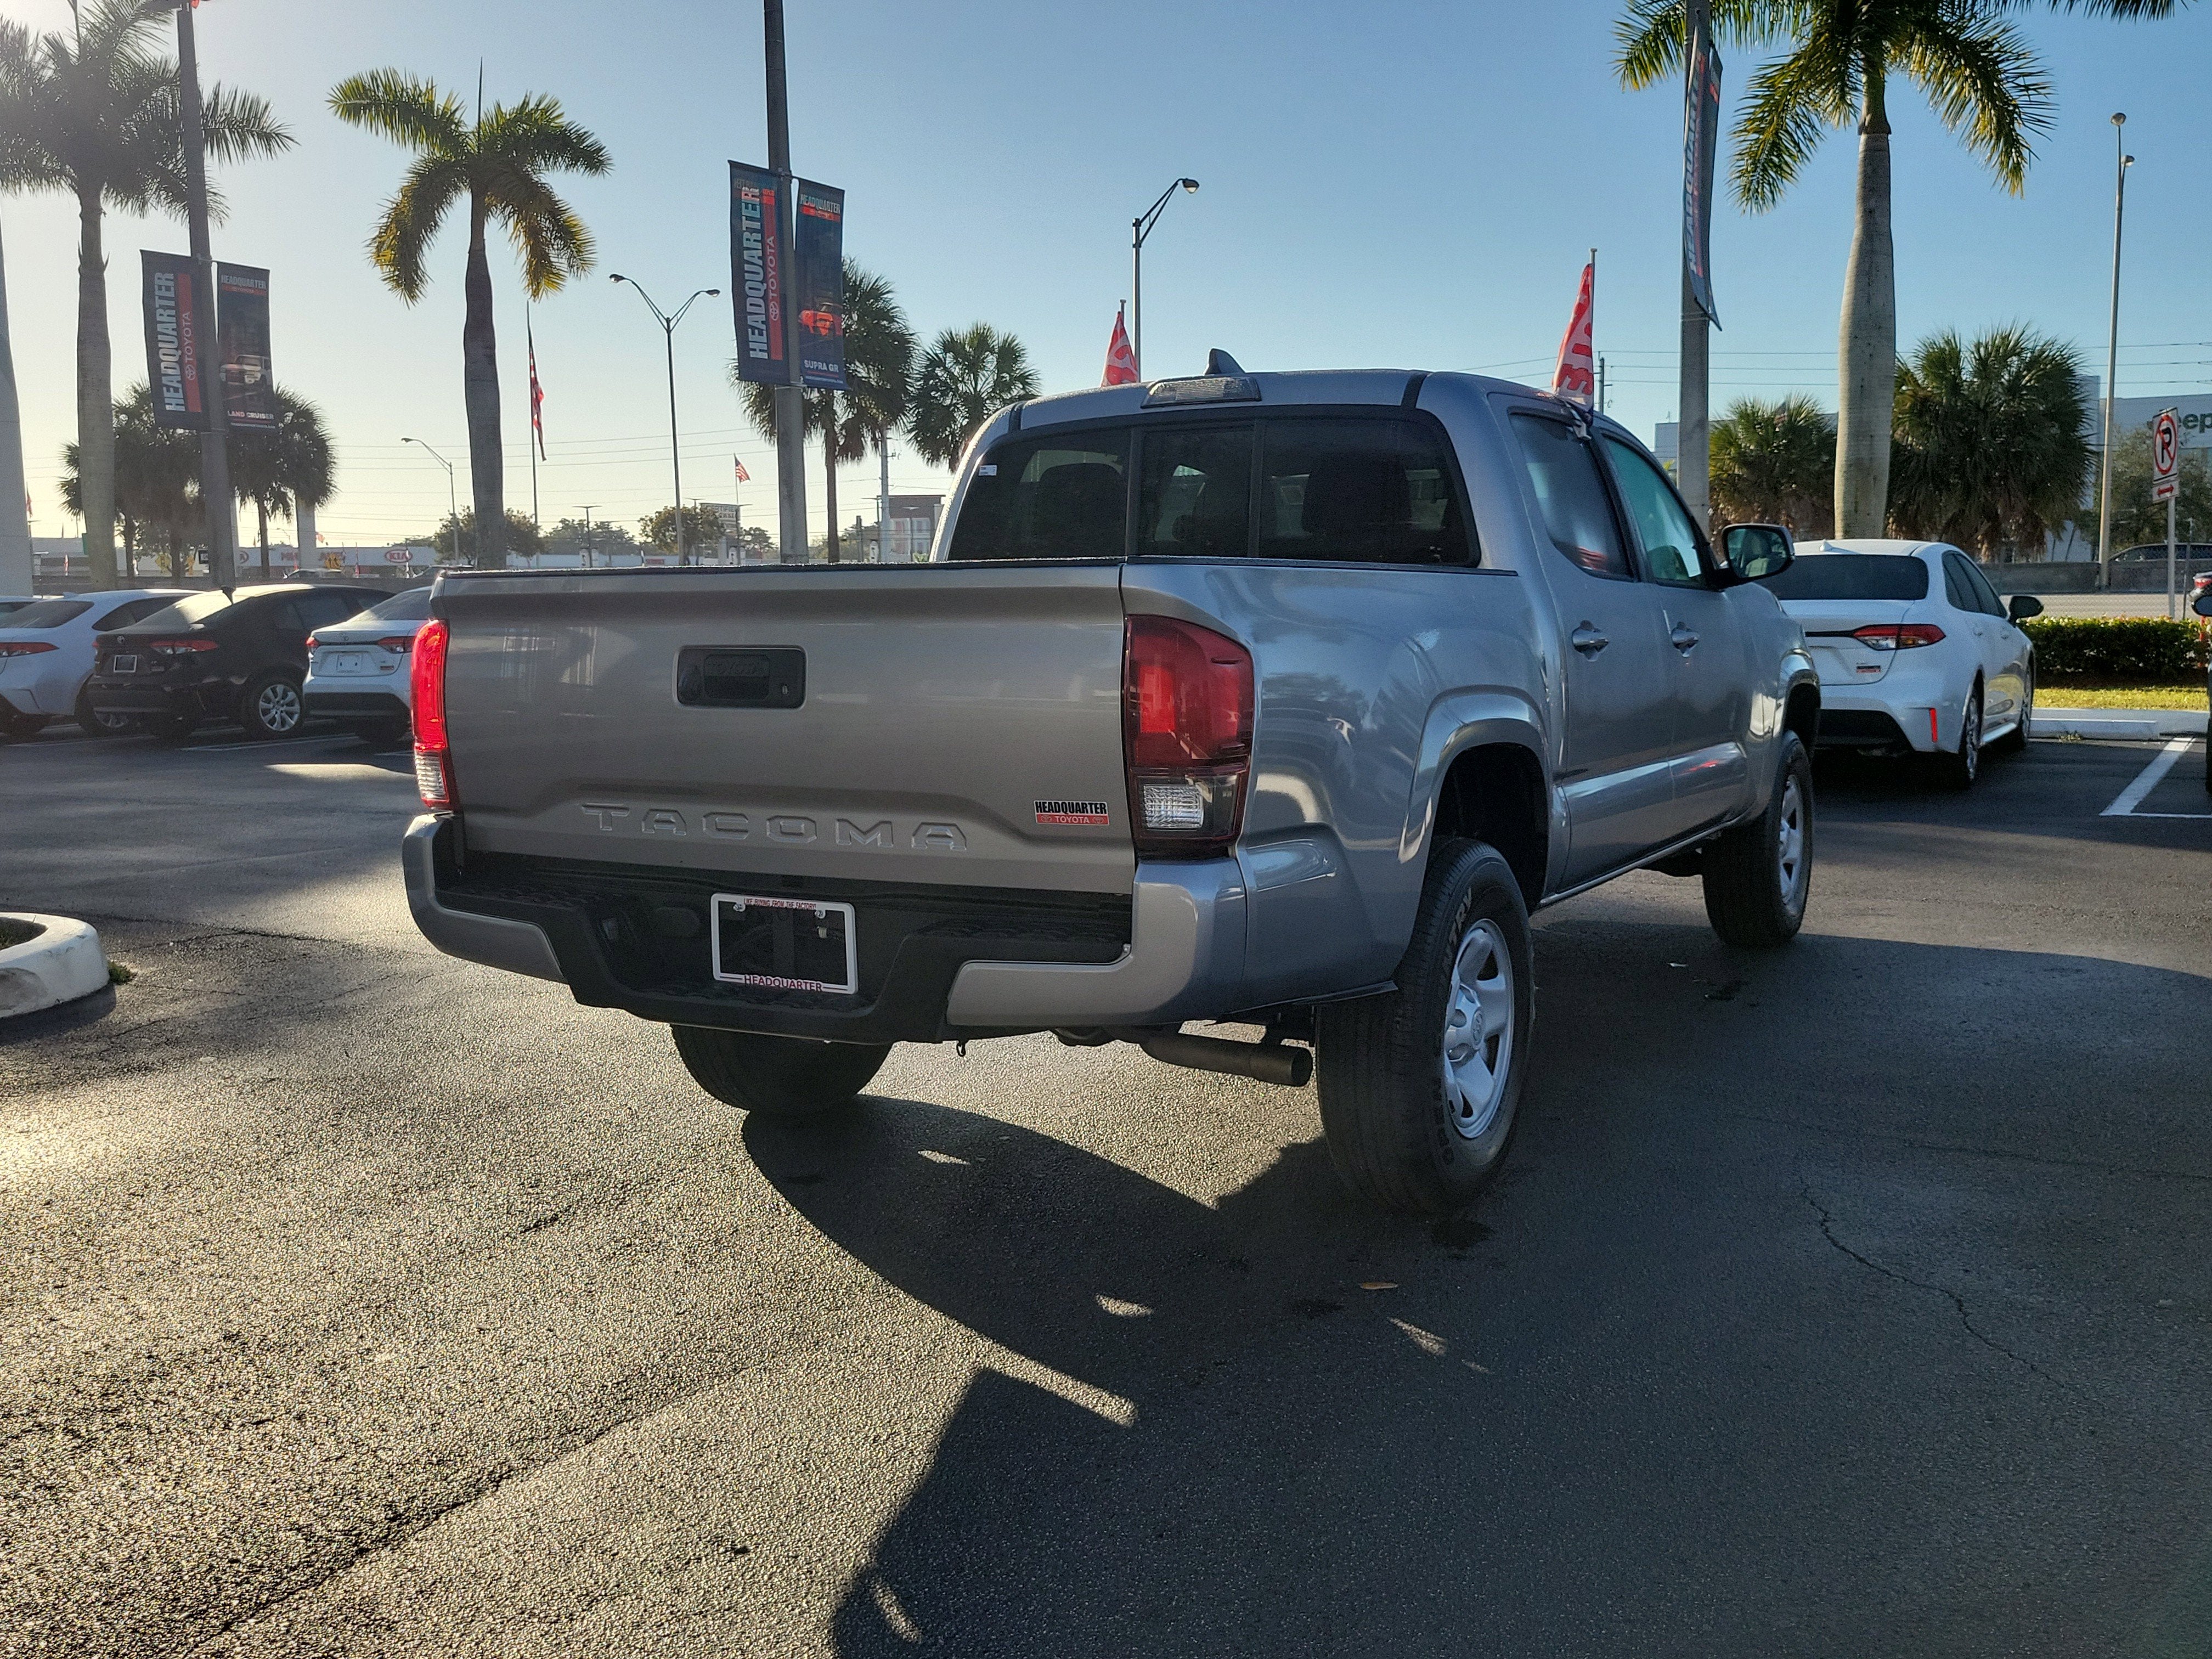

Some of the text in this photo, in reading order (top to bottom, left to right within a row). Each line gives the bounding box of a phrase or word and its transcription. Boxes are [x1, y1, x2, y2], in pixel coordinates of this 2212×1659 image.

[800, 194, 840, 214] HEADQUARTER
[741, 187, 768, 359] HEADQUARTER
[766, 236, 778, 298] TOYOTA
[221, 275, 267, 290] HEADQUARTER
[155, 273, 185, 411] HEADQUARTER
[183, 312, 193, 363] TOYOTA
[804, 360, 839, 373] SUPRA GR
[246, 411, 274, 420] CRUISER
[1035, 801, 1107, 815] HEADQUARTER
[582, 802, 967, 852] TACOMA
[1054, 815, 1090, 824] TOYOTA
[754, 899, 770, 907] BUYING
[744, 975, 823, 992] HEADQUARTER
